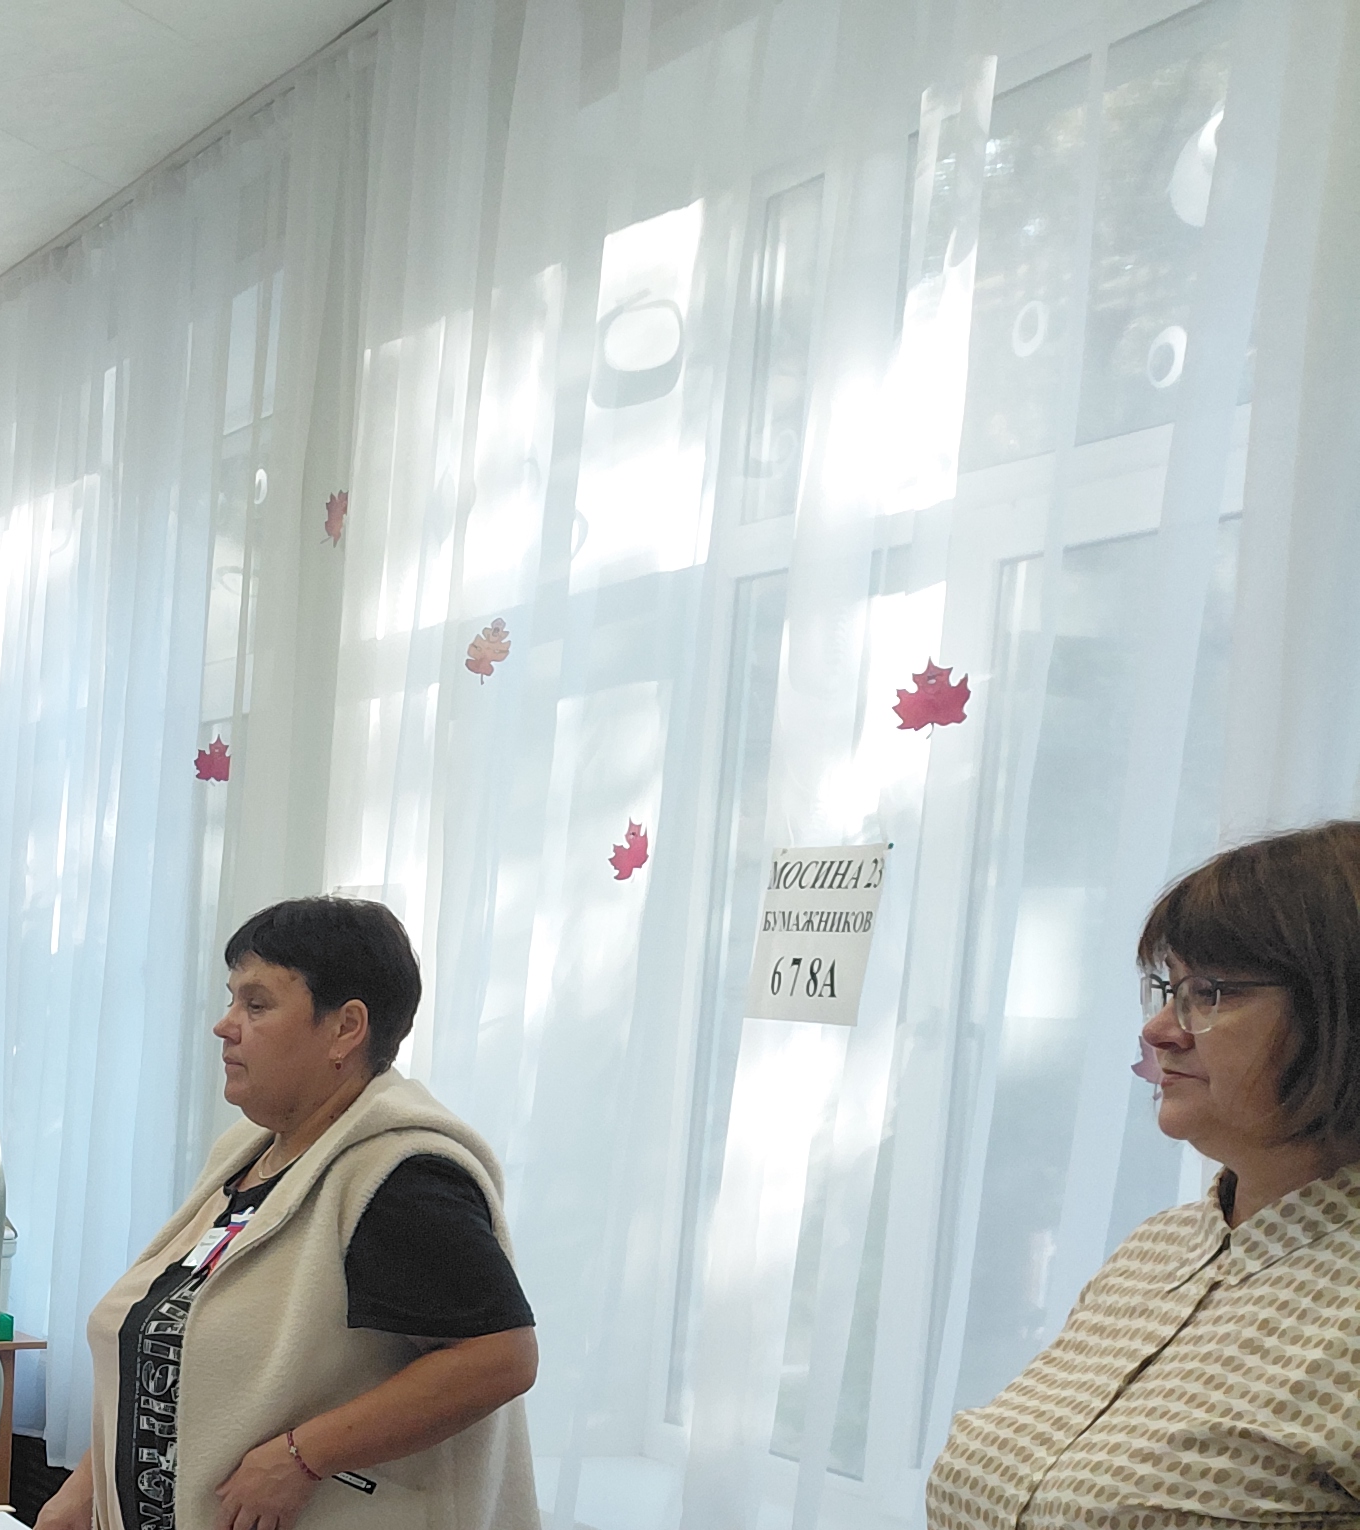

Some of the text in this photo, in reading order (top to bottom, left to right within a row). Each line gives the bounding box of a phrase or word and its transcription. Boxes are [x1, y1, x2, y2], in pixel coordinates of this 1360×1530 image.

[766, 859, 864, 890] МОСИНА
[762, 911, 874, 933] БУМАЖНИКОВ
[770, 956, 785, 996] 6
[789, 957, 803, 997] 7
